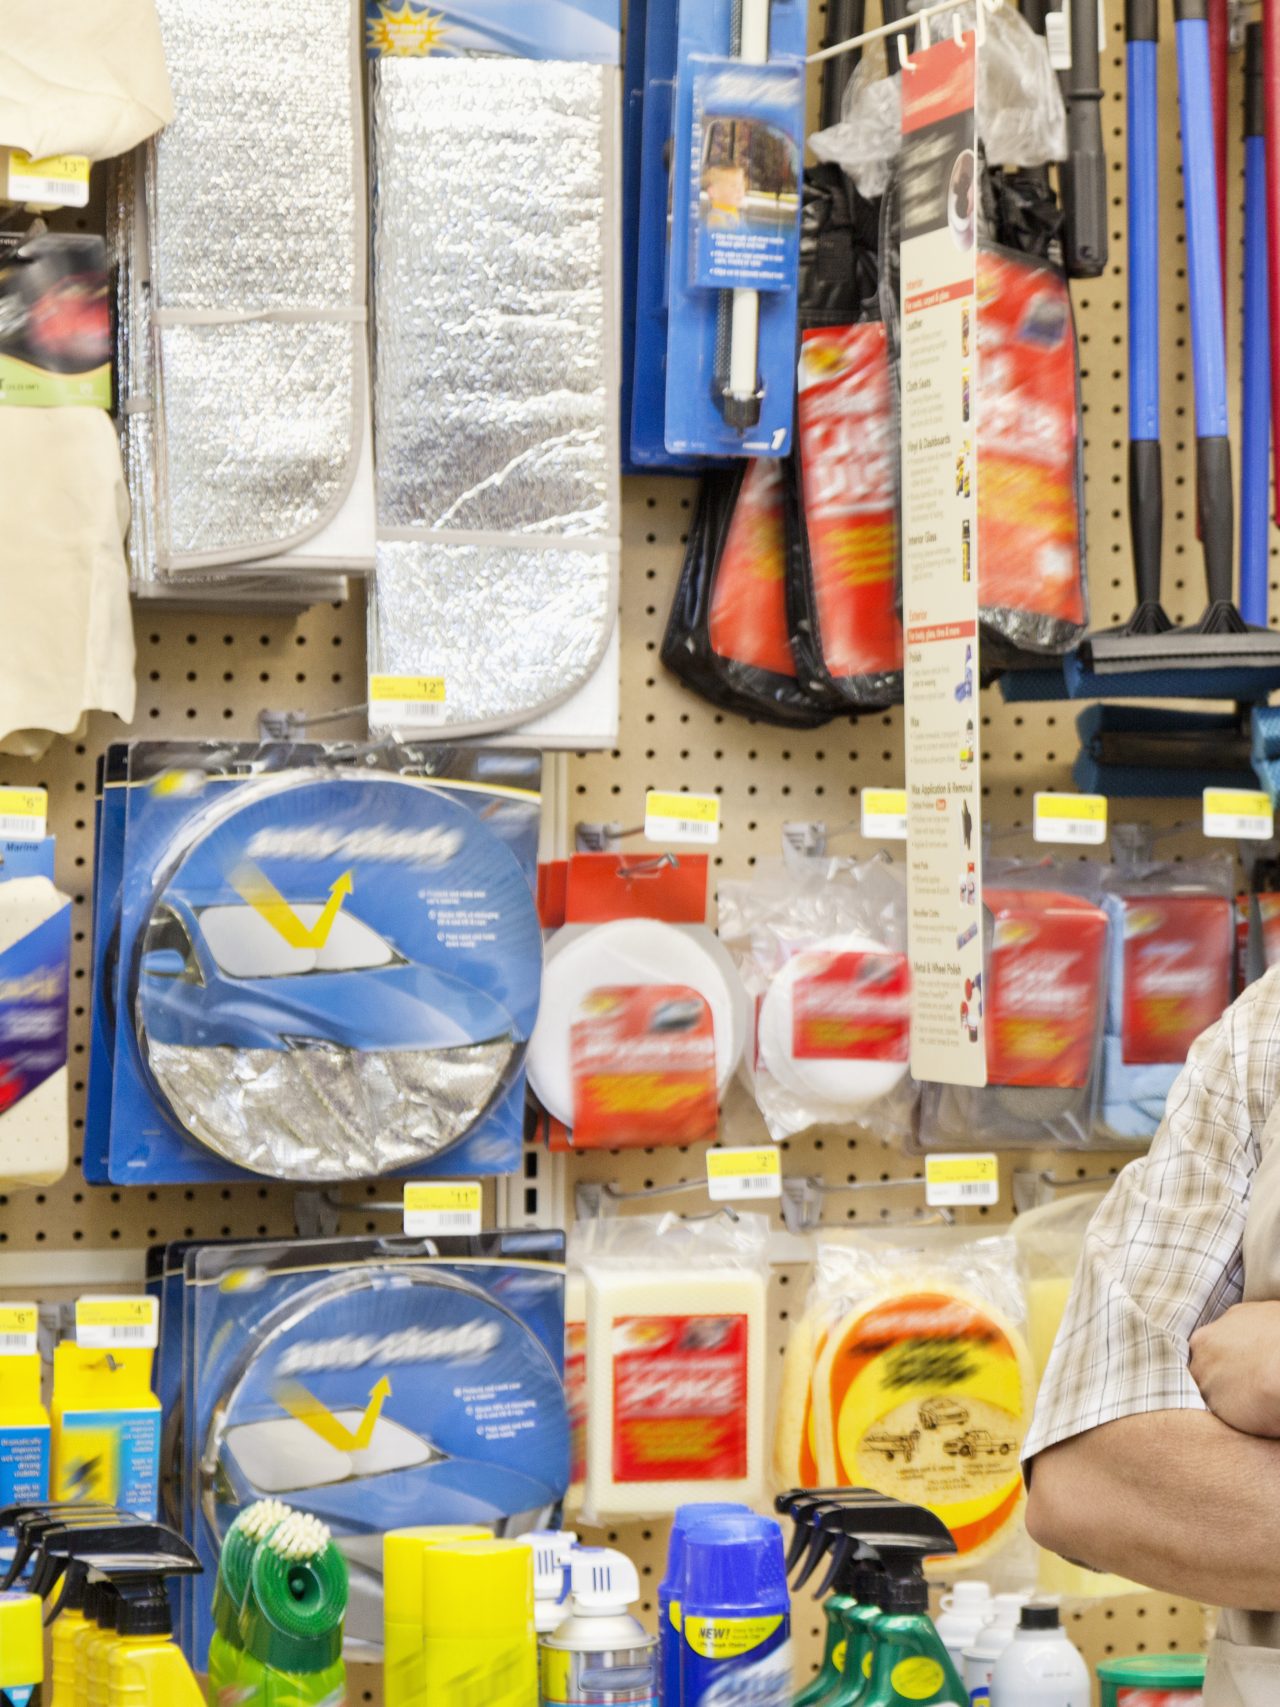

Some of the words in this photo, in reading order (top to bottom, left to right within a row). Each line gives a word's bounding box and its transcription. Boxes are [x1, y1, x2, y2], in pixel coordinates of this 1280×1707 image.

[908, 610, 928, 623] Exterior
[911, 784, 921, 795] Wax
[921, 783, 947, 797] Application
[951, 781, 973, 794] Removal
[5, 841, 40, 852] Marine
[698, 1627, 731, 1640] NEW!
